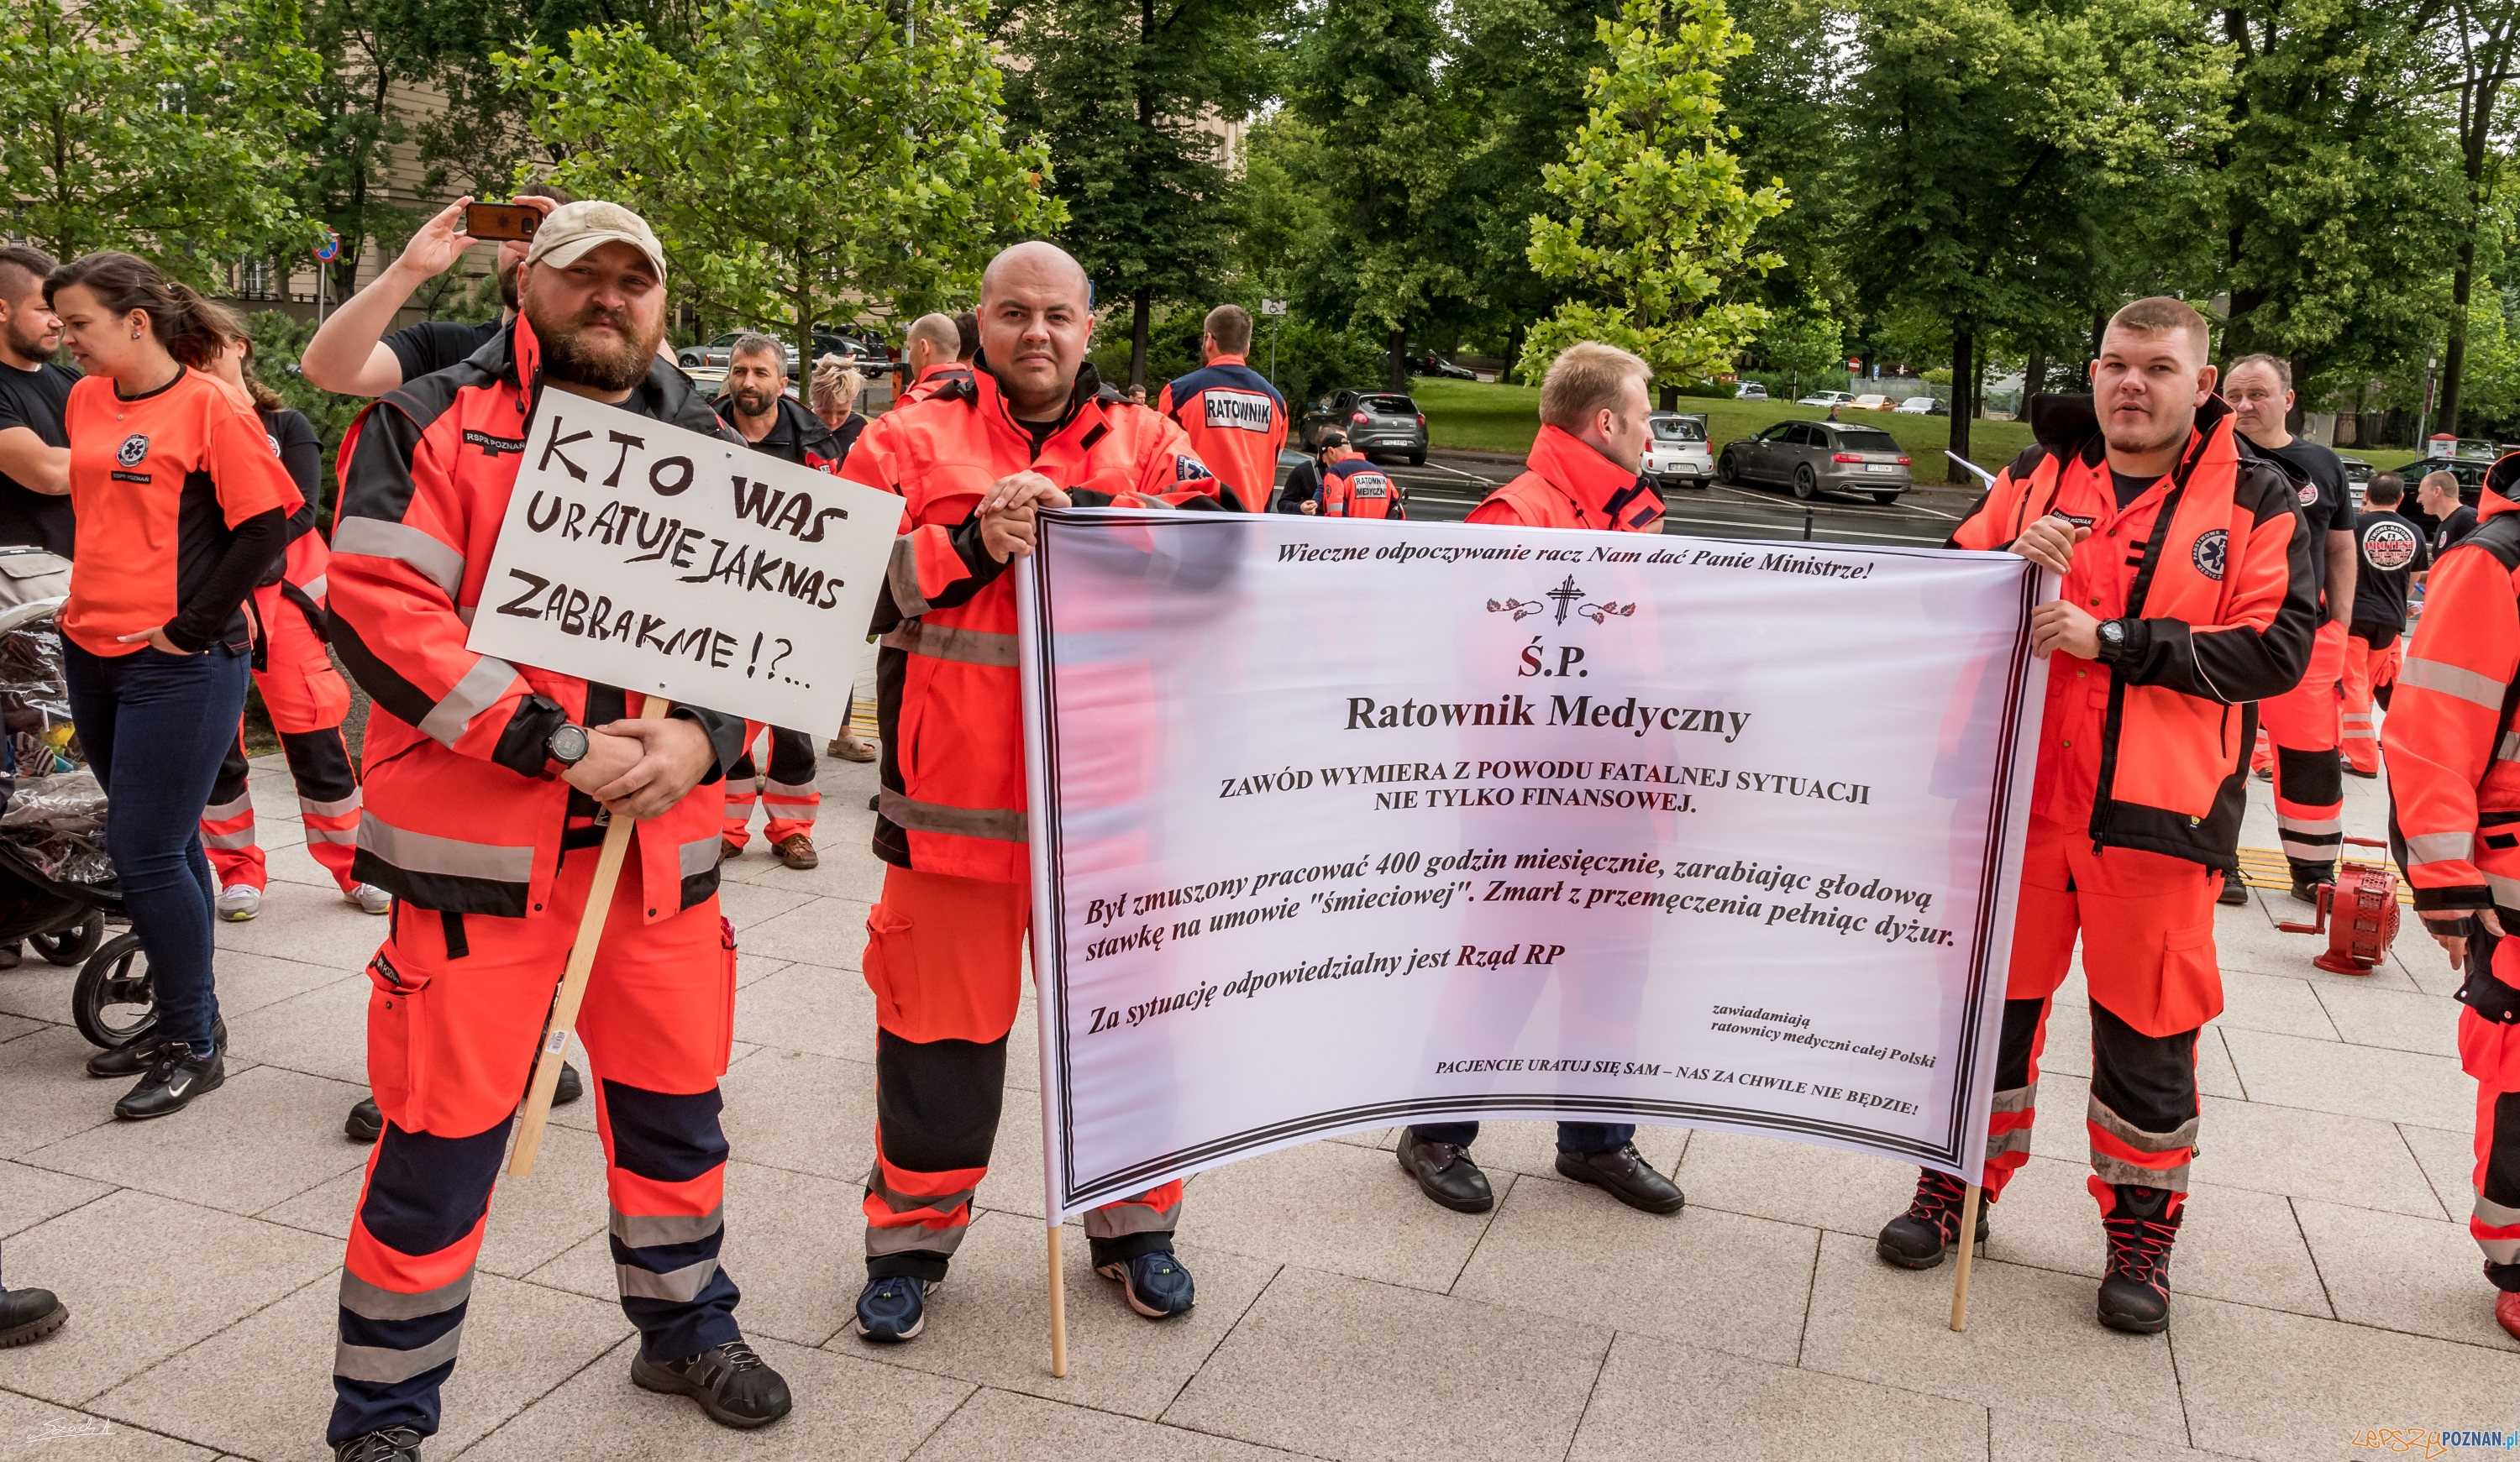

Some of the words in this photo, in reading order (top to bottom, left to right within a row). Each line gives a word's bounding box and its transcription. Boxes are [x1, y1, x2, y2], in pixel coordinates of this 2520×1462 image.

[1207, 399, 1269, 424] RATOWNIK
[466, 433, 490, 445] RSPR
[490, 439, 526, 450] POZNAŃ
[538, 416, 694, 496] KTO
[731, 475, 848, 543] WAS
[1278, 542, 1369, 563] Wieczne
[1375, 542, 1531, 563] odpoczywanie
[1536, 547, 1583, 563] racz
[1586, 546, 1642, 564] Nam
[1646, 548, 1688, 565] dać
[1689, 550, 1755, 569] Panie
[1758, 553, 1875, 580] Ministrze!
[2365, 541, 2414, 551] PROTEST
[1517, 636, 1589, 678] Ś.P.
[1344, 694, 1536, 731] Ratownik
[1546, 694, 1752, 743] Medyczny
[1219, 766, 1314, 799] ZAWÓD
[1320, 762, 1447, 788] WYMIERA
[1452, 761, 1471, 779] Z
[1476, 760, 1594, 780] POWODU
[1598, 762, 1731, 789] FATALNEJ
[1735, 771, 1872, 805] SYTUACJI
[1373, 790, 1419, 811] NIE
[1425, 788, 1515, 808] TYLKO
[1520, 787, 1697, 814] FINANSOWEJ.
[1084, 892, 1128, 928] Był
[1132, 877, 1248, 916] zmuszony
[1250, 855, 1370, 897] pracować
[1375, 851, 1420, 876] 400
[1424, 848, 1508, 878] godzin
[1514, 848, 1665, 879] miesięcznie,
[1673, 861, 1811, 894] zarabiając
[1815, 873, 1933, 914] głodową
[1085, 924, 1165, 962] stawkę
[1172, 918, 1201, 941] na
[1209, 897, 1300, 932] umowie
[1310, 881, 1475, 915] "śmieciowej".
[1483, 880, 1565, 903] Zmarł
[1568, 891, 1581, 904] z
[1583, 887, 1761, 917] przemęczenia
[1764, 903, 1868, 935] pełniąc
[1874, 914, 1954, 947] dyżur.
[1088, 1006, 1121, 1035] Za
[1126, 980, 1218, 1027] sytuację
[1223, 951, 1403, 999] odpowiedzialny
[1403, 947, 1452, 976] jest
[1454, 944, 1520, 972] Rząd
[1522, 944, 1566, 966] RP
[1712, 1003, 1811, 1030] zawiadamiają
[1710, 1020, 1781, 1042] ratownicy
[1782, 1031, 1851, 1051] medyczni
[1851, 1047, 1887, 1061] całej
[1888, 1048, 1936, 1069] Polski
[1435, 1059, 1524, 1074] PACJENCIE
[1527, 1059, 1592, 1072] URATUJ
[1593, 1061, 1620, 1077] SIĘ
[1623, 1061, 1661, 1076] SAM
[1675, 1066, 1710, 1081] NAS
[1712, 1069, 1735, 1083] ZA
[1738, 1073, 1808, 1094] CHWILE
[1810, 1084, 1843, 1100] NIE
[1845, 1090, 1919, 1116] BĘDZIE!
